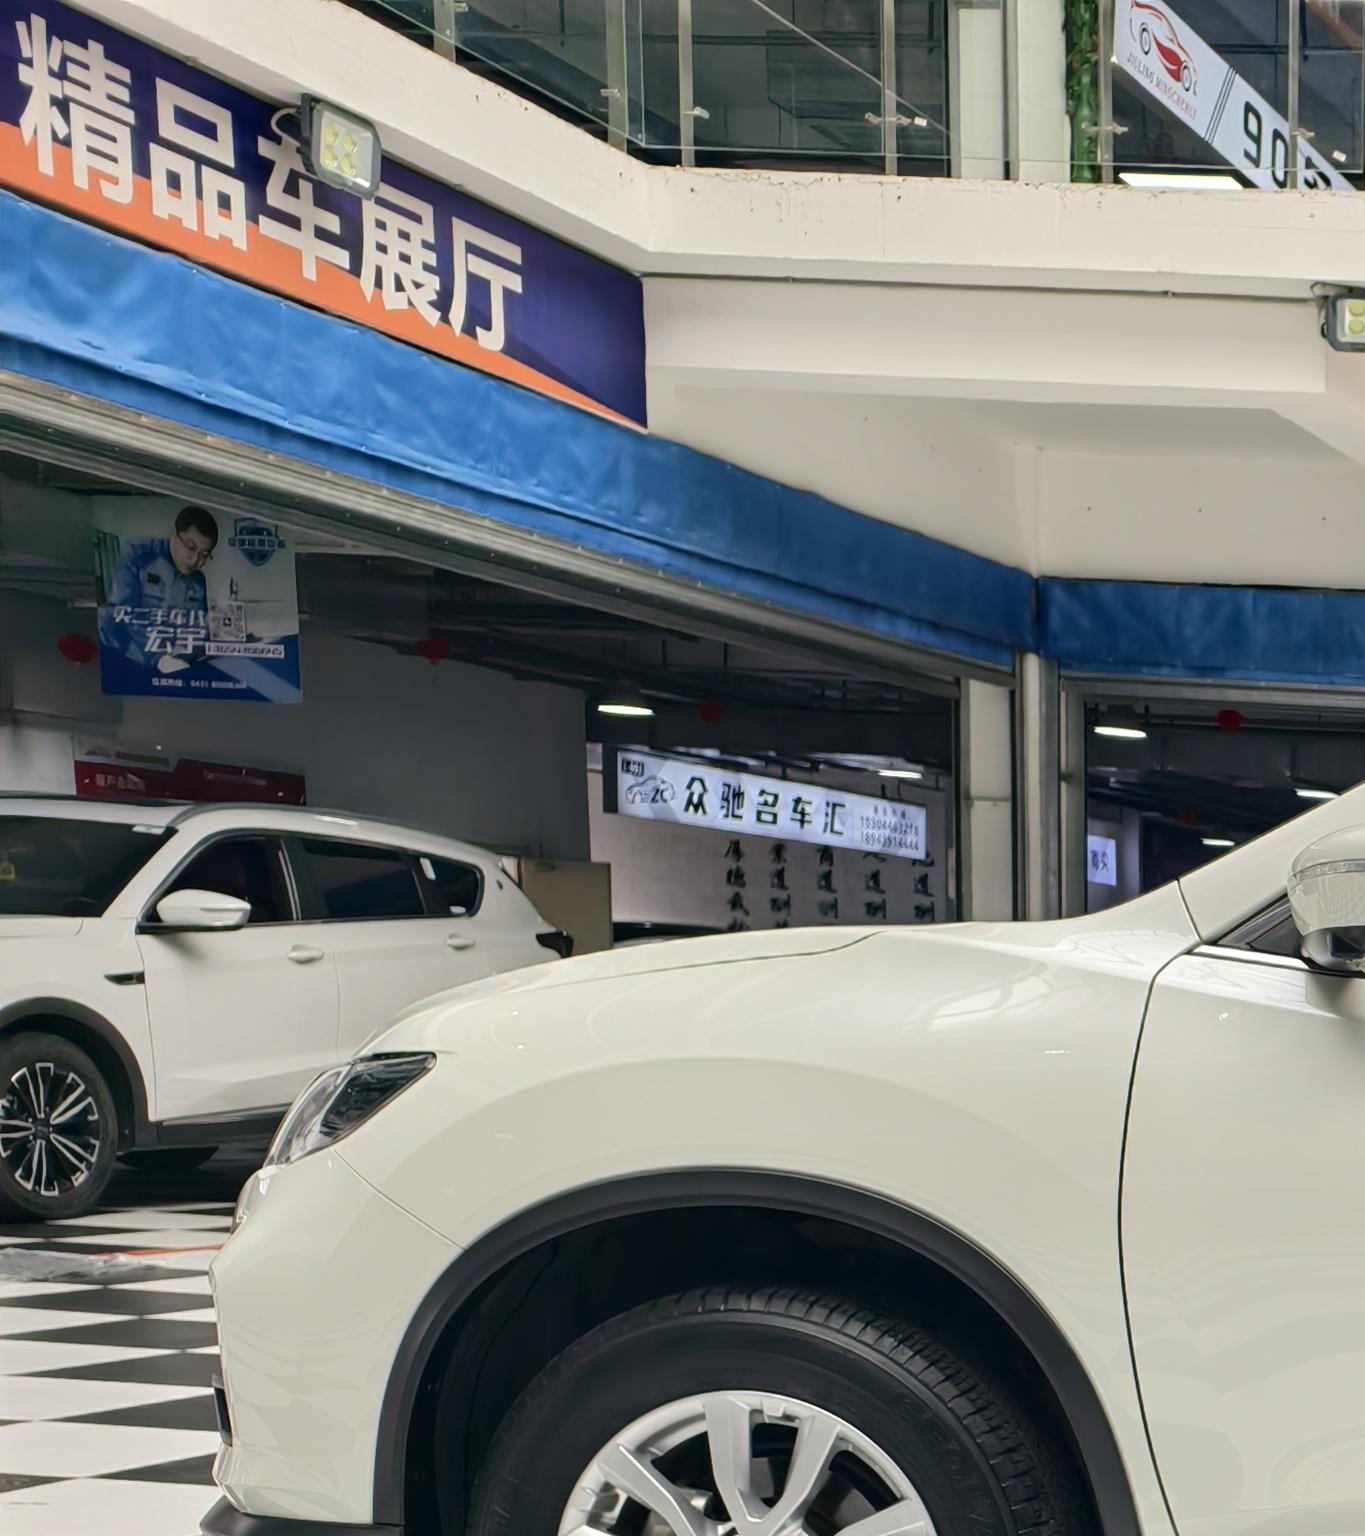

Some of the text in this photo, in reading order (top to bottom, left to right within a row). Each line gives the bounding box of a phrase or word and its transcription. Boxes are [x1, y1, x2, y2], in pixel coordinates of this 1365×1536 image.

[16, 14, 522, 351] 精品车展厅
[683, 776, 846, 836] 众驰名车汇
